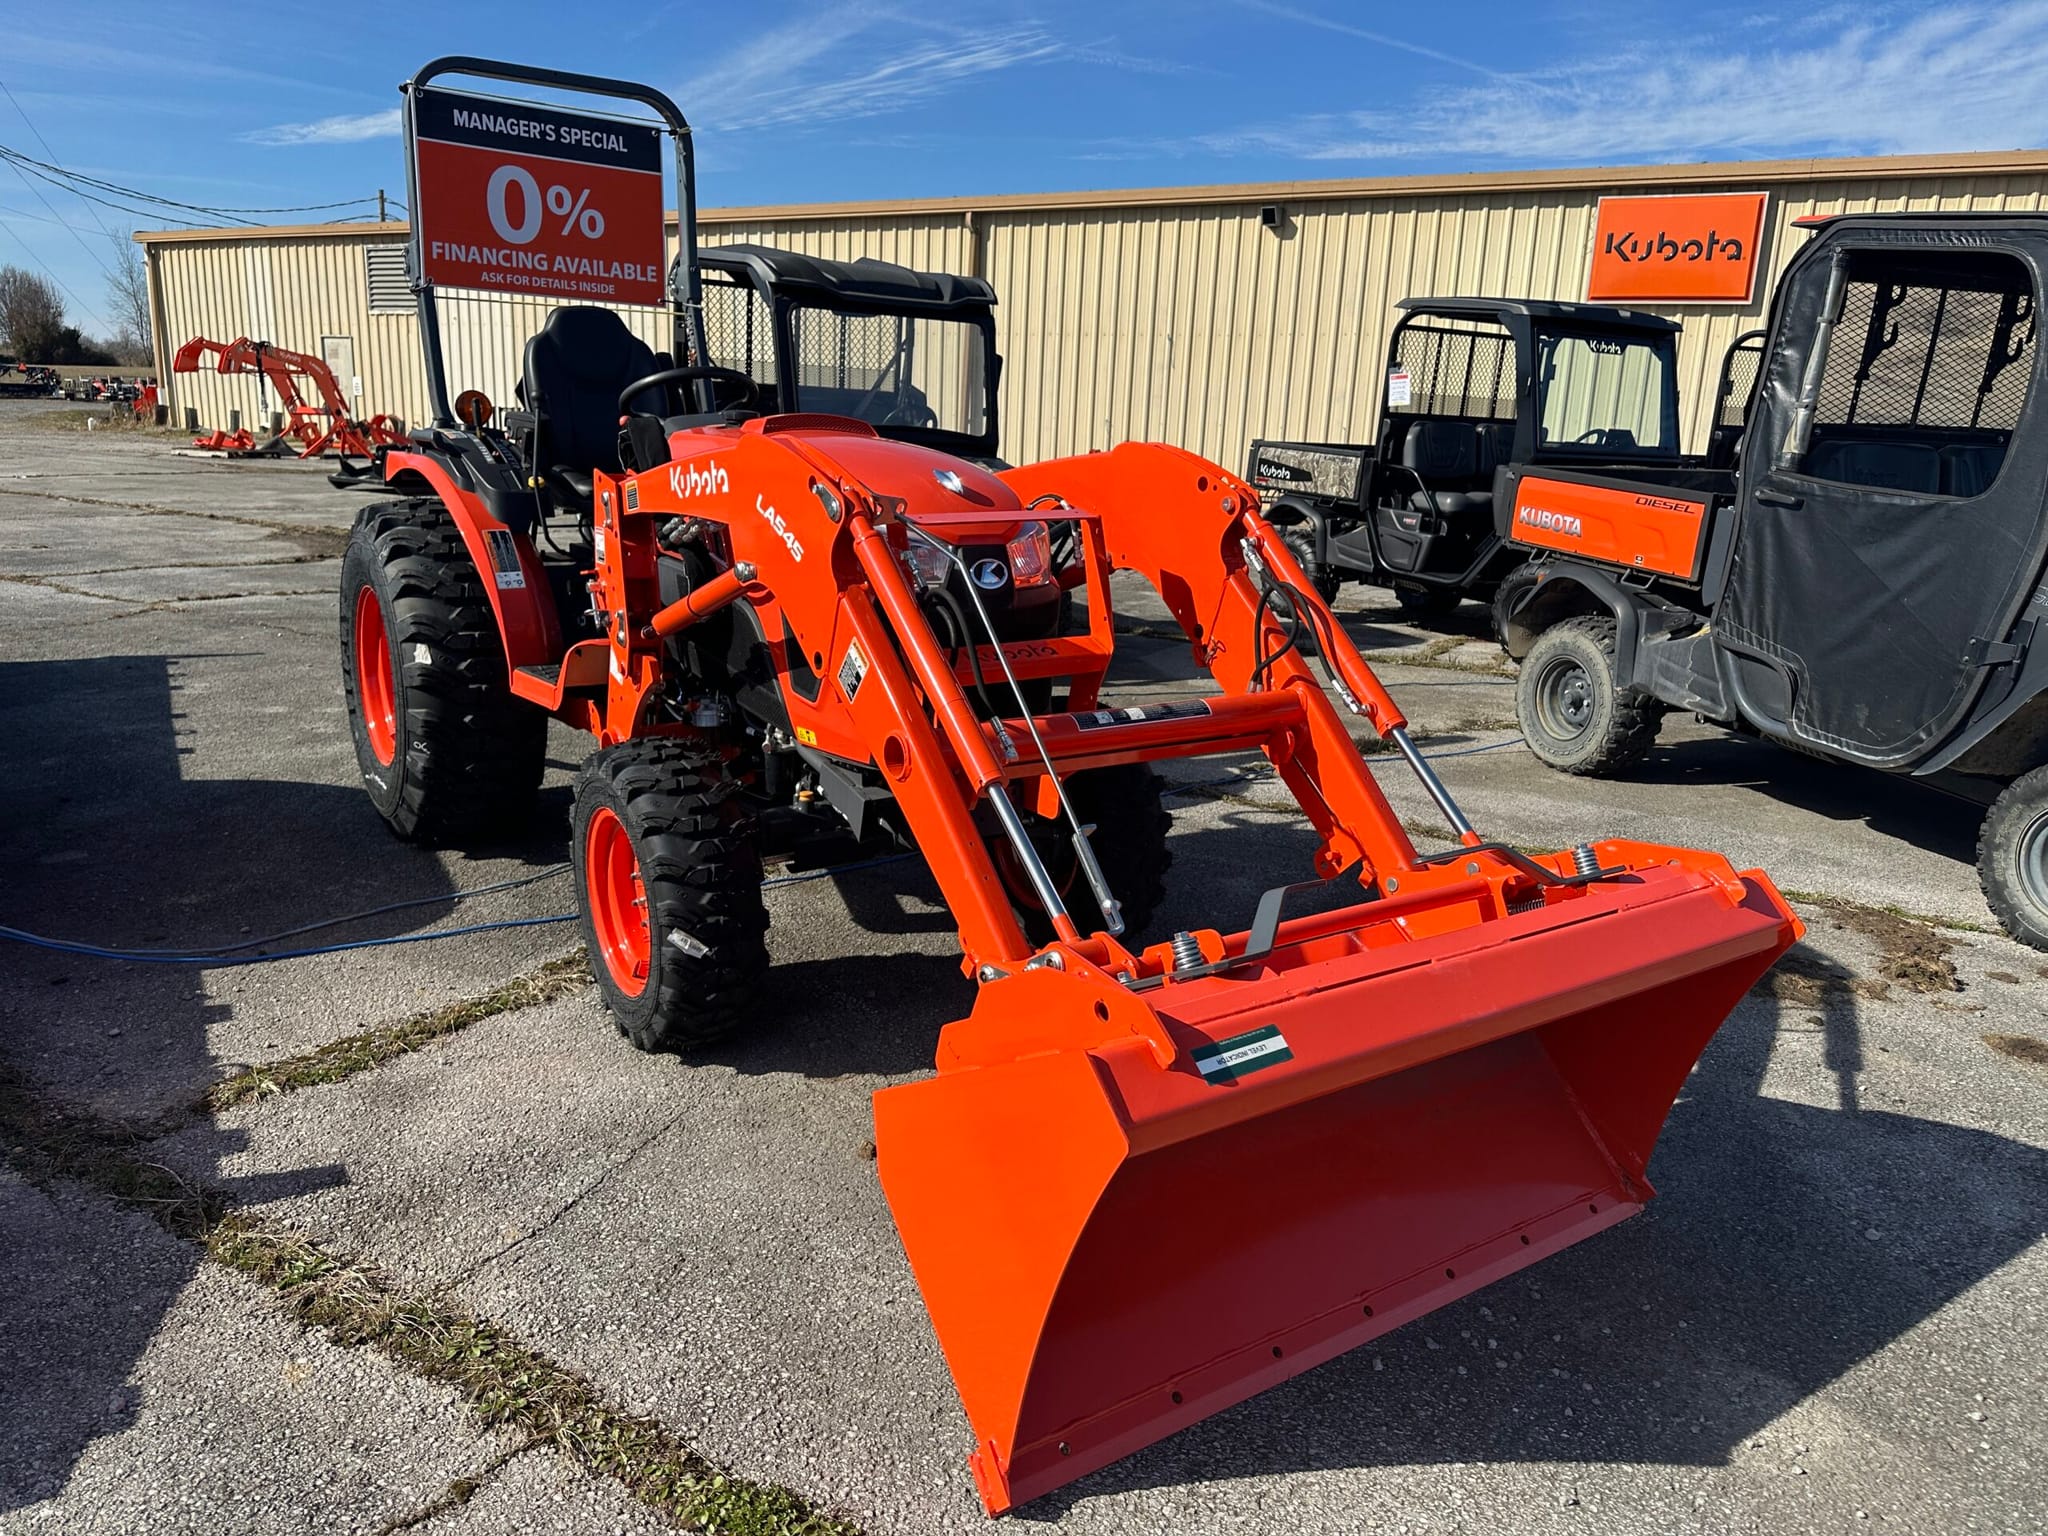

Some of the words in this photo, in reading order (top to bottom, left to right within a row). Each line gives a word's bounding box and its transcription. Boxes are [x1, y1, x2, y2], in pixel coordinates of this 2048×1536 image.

[453, 108, 556, 142] MANAGER'S
[560, 126, 628, 153] SPECIAL
[486, 165, 605, 245] 0%
[431, 241, 548, 271] FINANCING
[552, 255, 657, 283] AVAILABLE
[1605, 230, 1743, 262] Kubota
[480, 271, 504, 285] ASK
[506, 274, 530, 286] FOR
[532, 276, 577, 292] DETAILS
[579, 281, 616, 295] INSIDE
[669, 460, 729, 498] Kubota
[1260, 463, 1291, 480] Kubota
[1519, 505, 1582, 538] KUBOTA
[1635, 496, 1696, 515] DIESEL
[755, 493, 804, 563] LA545
[1248, 1044, 1267, 1055] LEVEL
